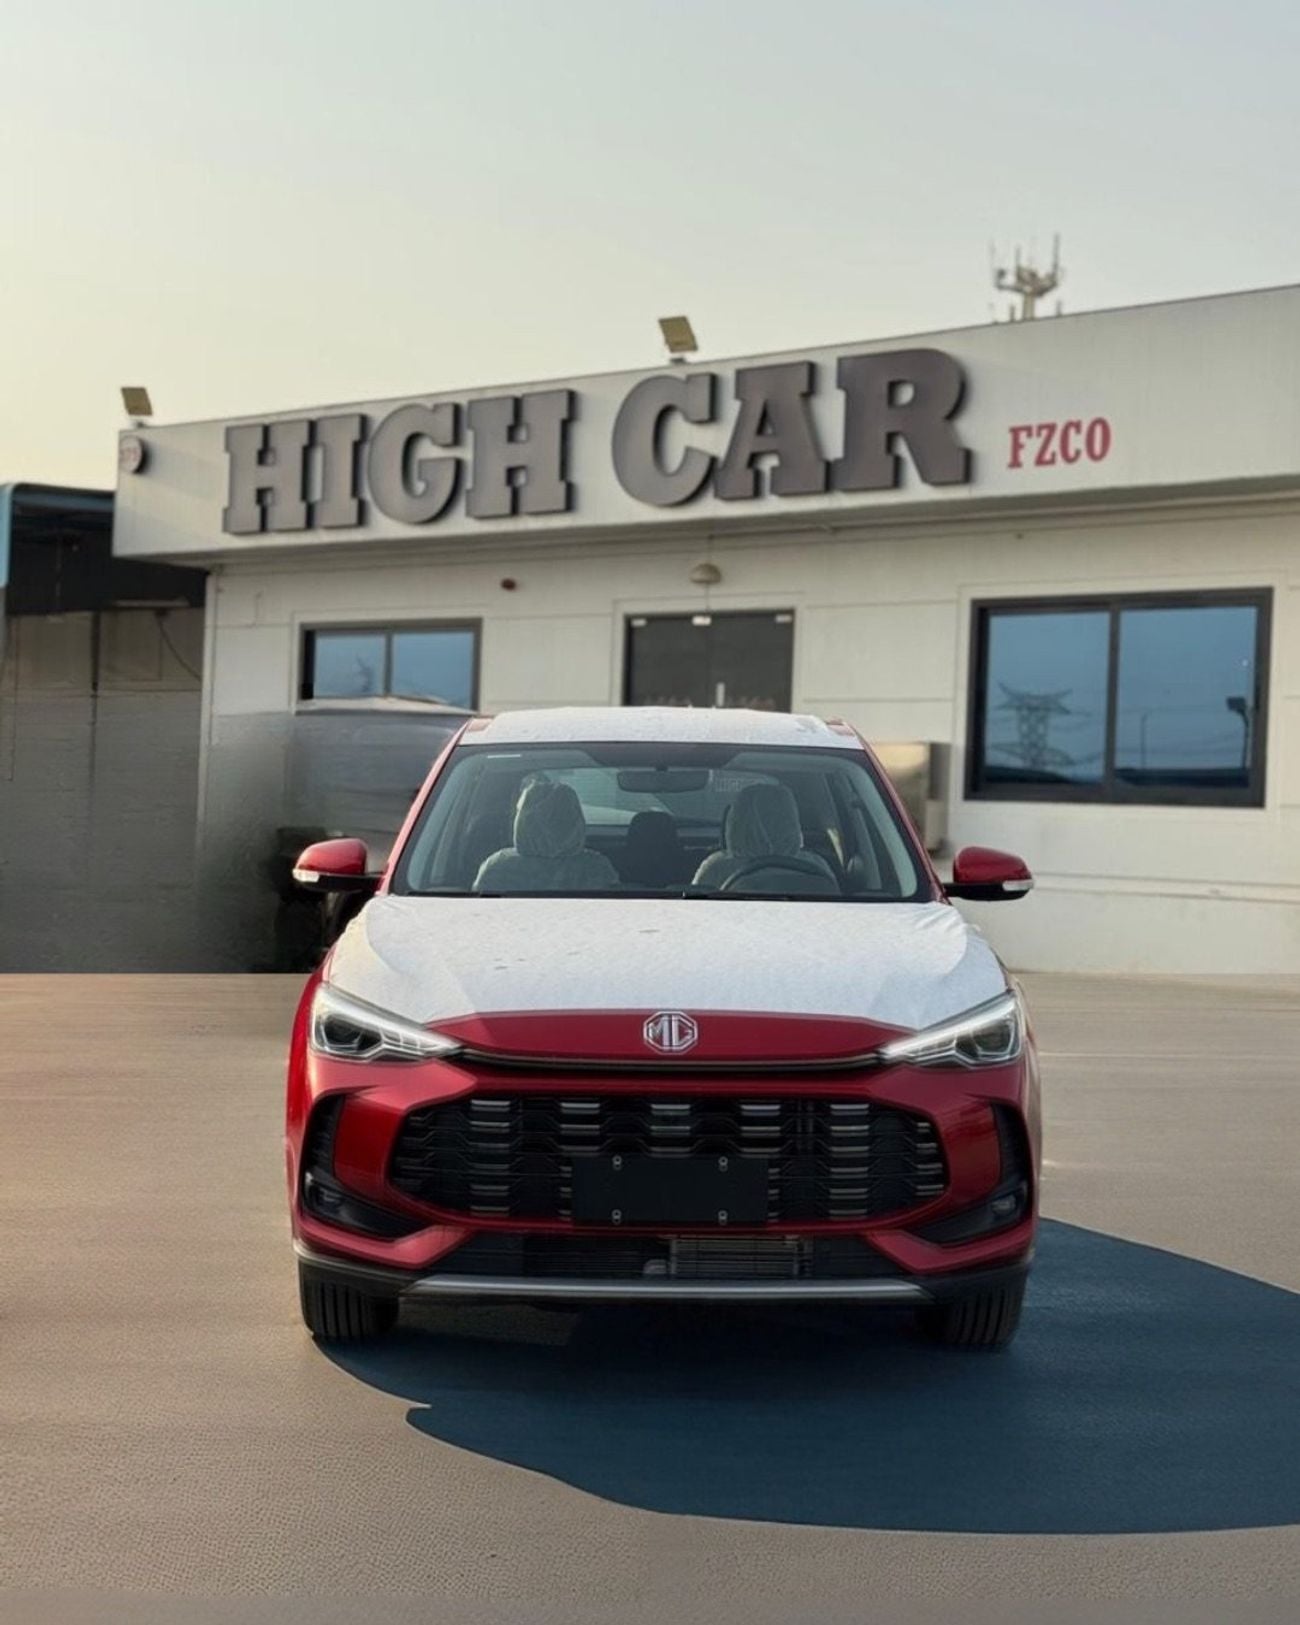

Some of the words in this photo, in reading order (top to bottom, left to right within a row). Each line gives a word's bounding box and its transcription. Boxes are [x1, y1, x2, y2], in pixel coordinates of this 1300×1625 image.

[222, 389, 577, 536] HIGH
[611, 348, 972, 507] CAR
[1007, 417, 1112, 469] FZCO
[645, 1012, 696, 1050] MG
